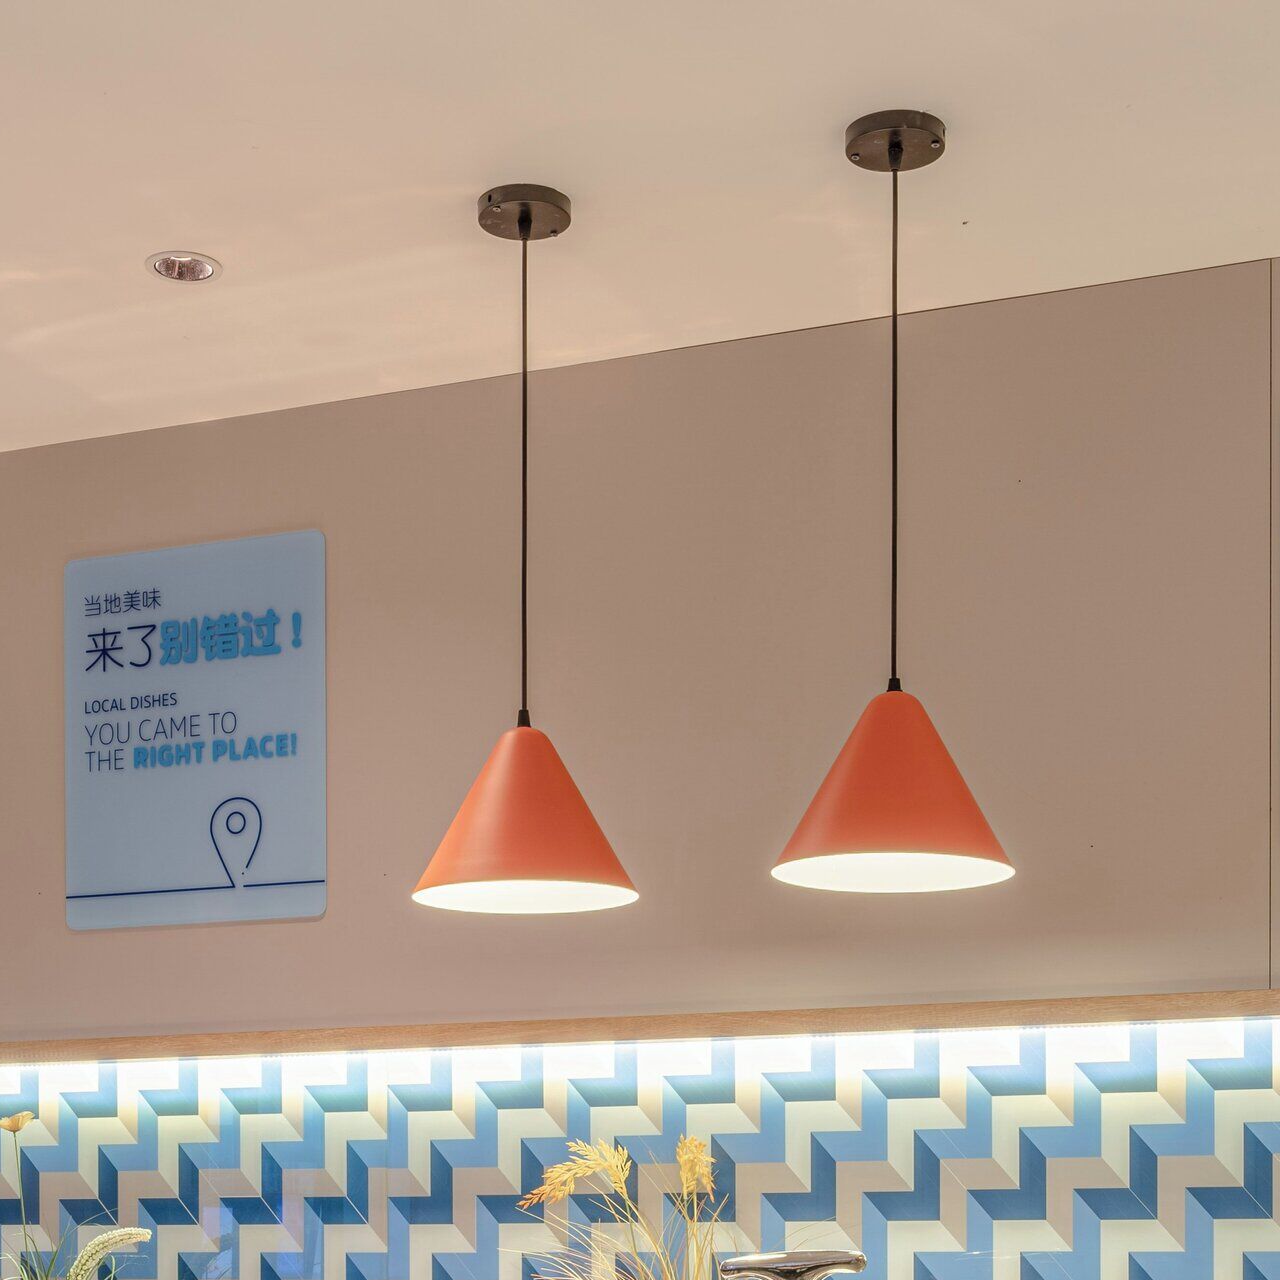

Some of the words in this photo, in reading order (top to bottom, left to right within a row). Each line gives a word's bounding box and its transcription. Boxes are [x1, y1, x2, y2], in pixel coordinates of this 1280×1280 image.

[84, 587, 162, 617] 当地美味
[85, 608, 302, 672] 来了别错过！
[84, 697, 126, 714] LOCAL
[130, 692, 178, 710] DISHES
[84, 720, 130, 746] YOU
[138, 714, 200, 742] CAME
[208, 711, 237, 735] TO
[84, 748, 124, 773] THE
[133, 741, 206, 769] RIGHT
[211, 732, 298, 763] PLACE!
